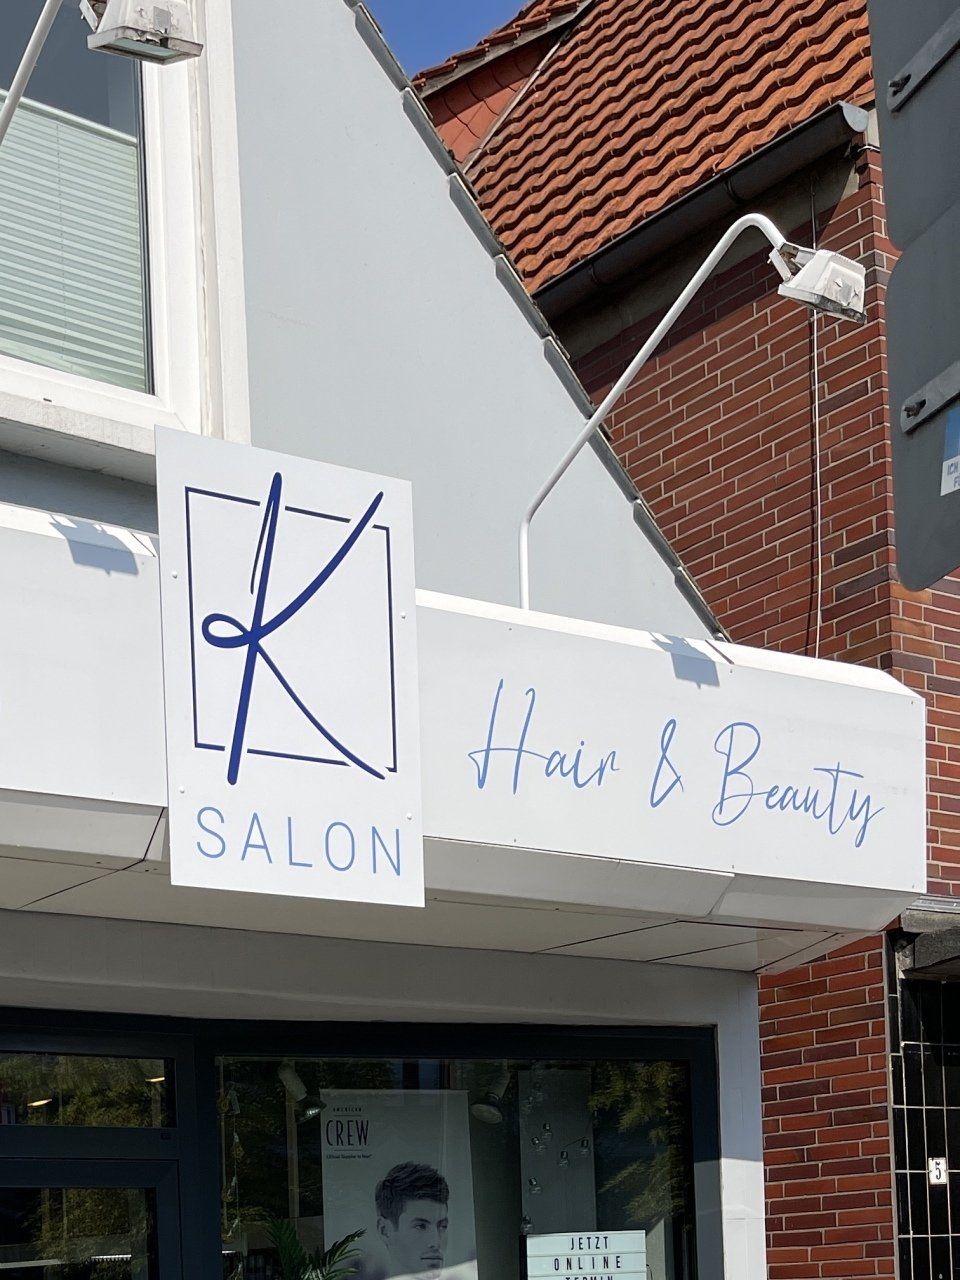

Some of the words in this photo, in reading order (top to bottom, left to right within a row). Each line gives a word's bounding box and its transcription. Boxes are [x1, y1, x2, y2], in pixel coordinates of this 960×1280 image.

[202, 472, 386, 786] K
[468, 678, 621, 796] Hair
[649, 718, 685, 809] &
[711, 721, 887, 849] Beauty
[196, 806, 402, 877] SALON
[326, 1119, 369, 1146] CREW
[935, 1161, 941, 1180] 5
[571, 1236, 608, 1250] JETZT
[554, 1256, 621, 1271] ONLINE
